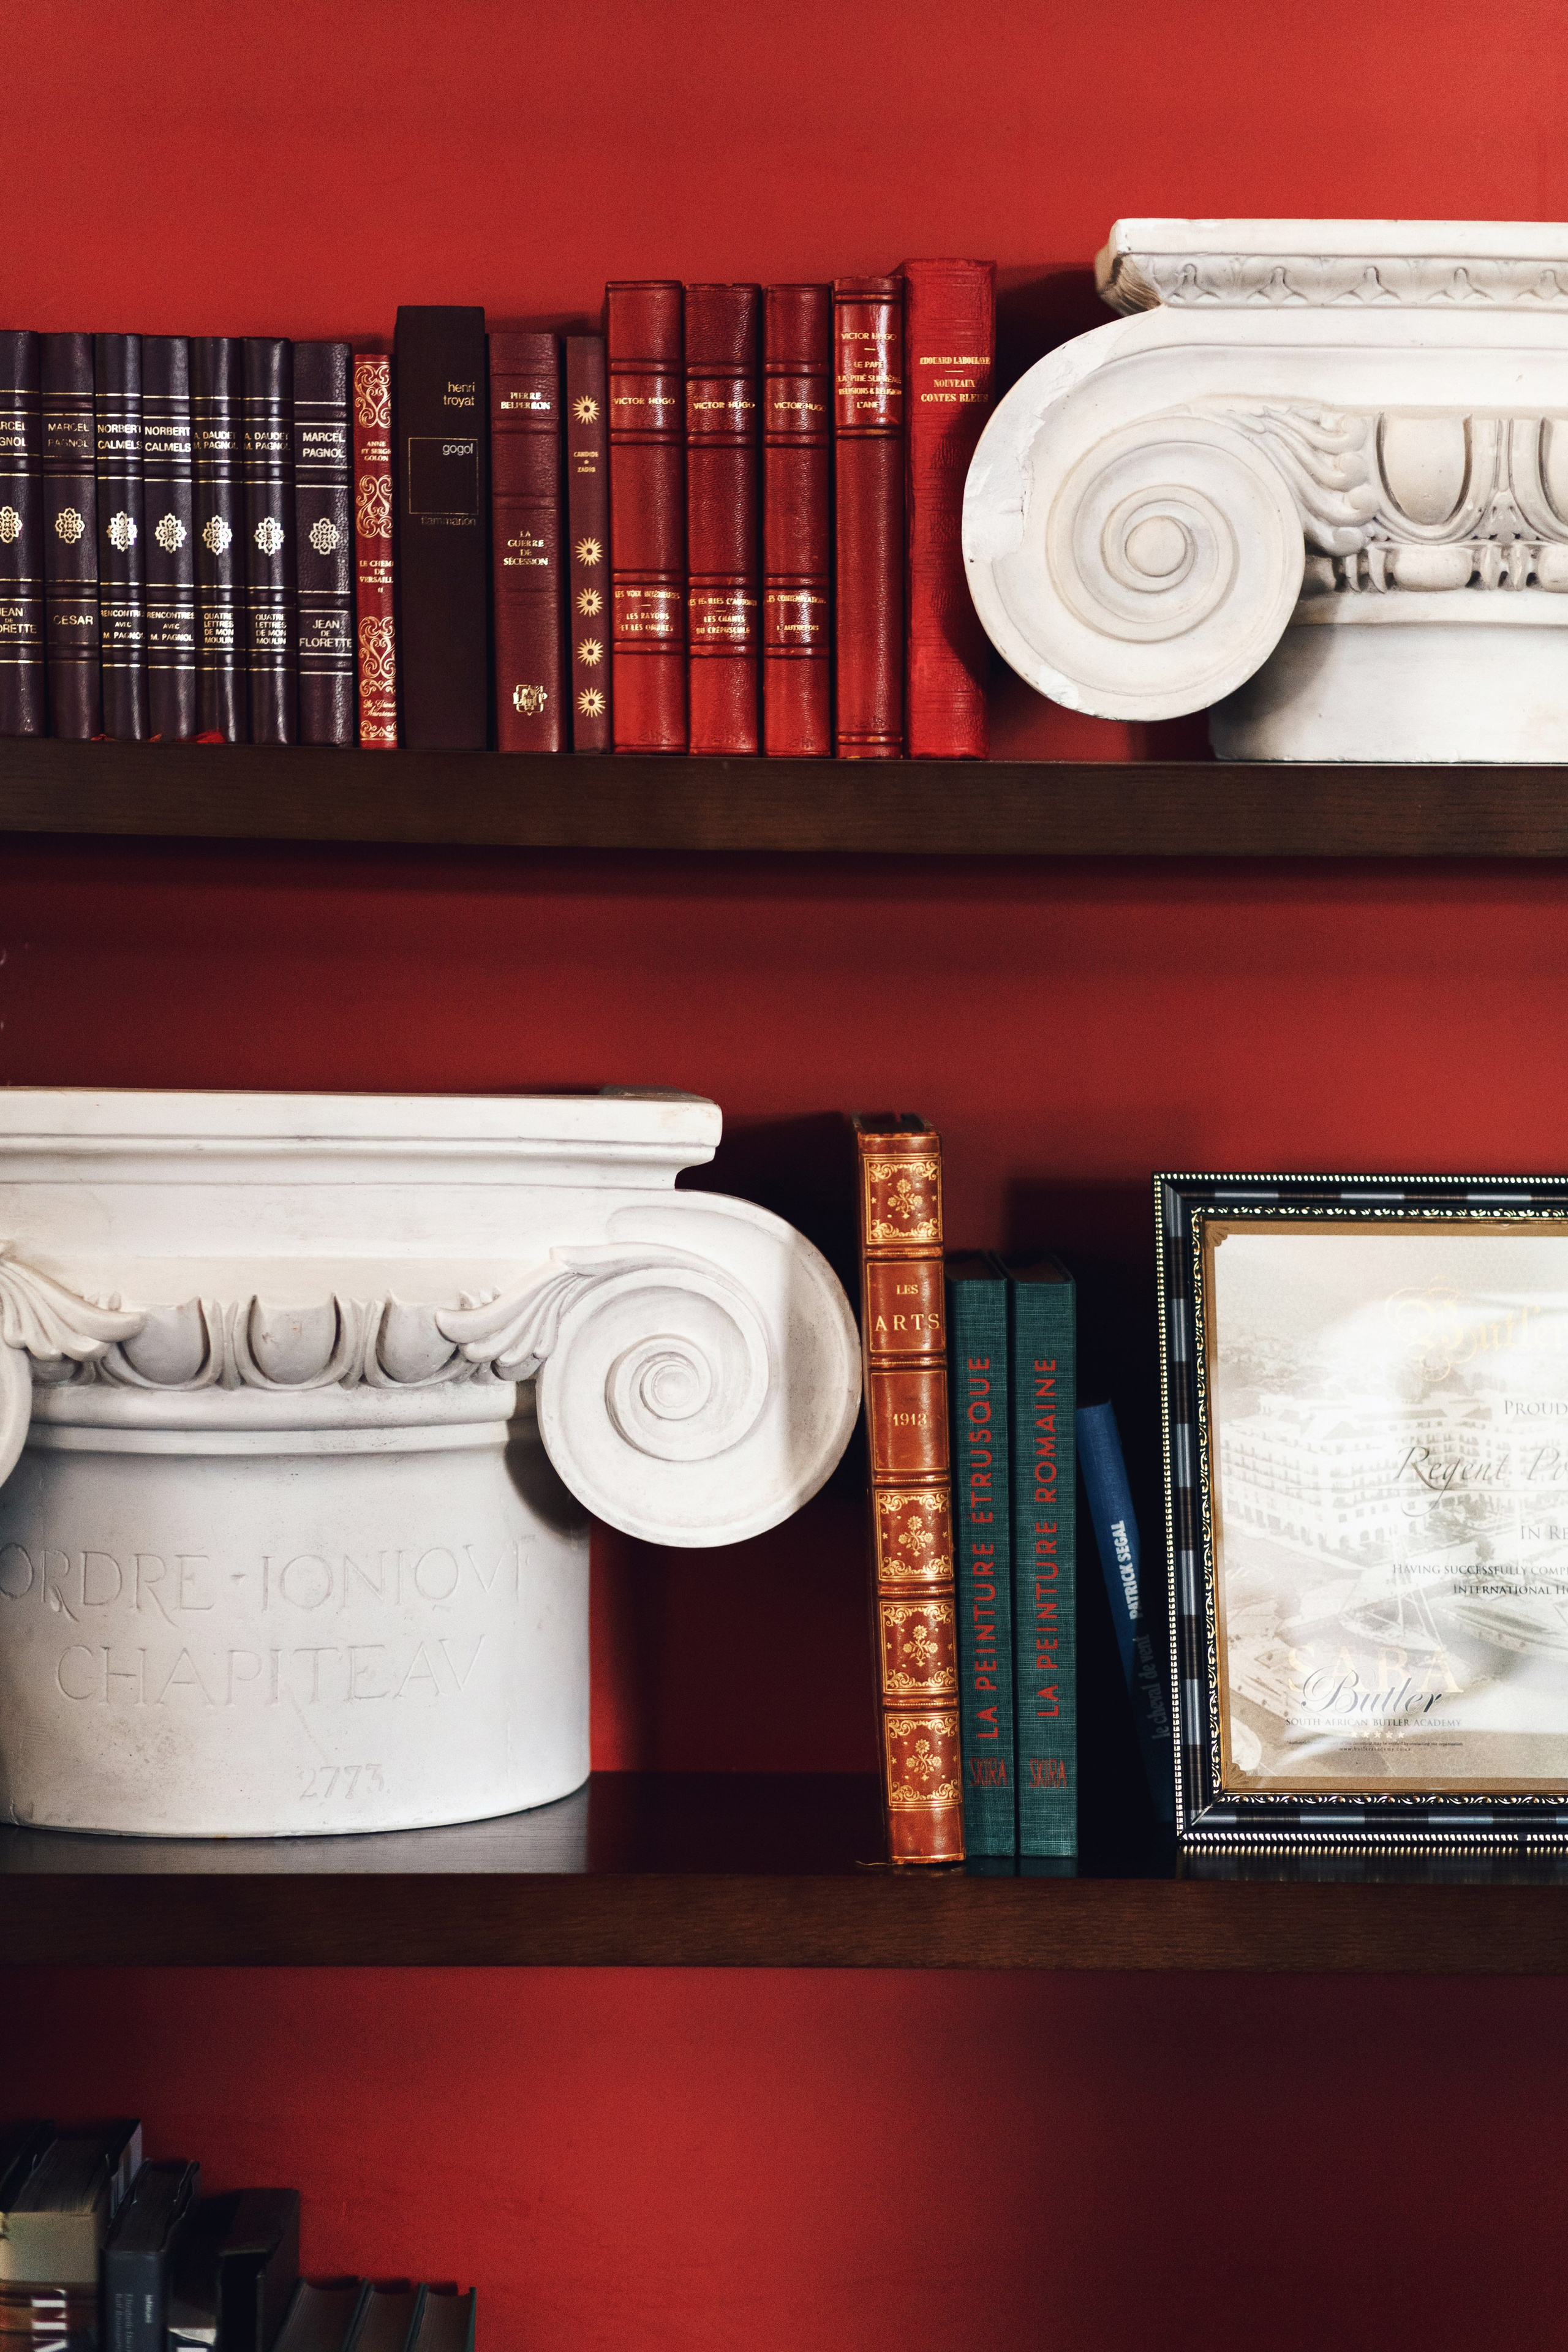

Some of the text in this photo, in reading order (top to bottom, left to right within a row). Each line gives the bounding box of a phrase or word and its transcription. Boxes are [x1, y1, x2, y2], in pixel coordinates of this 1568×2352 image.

[872, 332, 897, 341] HUGO
[448, 382, 475, 392] henri
[933, 379, 976, 388] NOUVEAUX
[443, 395, 475, 408] troyat
[921, 393, 989, 402] CONTES BLEUS
[500, 401, 551, 410] BELPERRON
[805, 403, 826, 412] HUGO
[0, 421, 28, 431] RCEL
[48, 423, 90, 432] MARCEL
[97, 424, 141, 434] NORBERT
[145, 426, 190, 436] NORBERT
[203, 431, 236, 440] DAUDET
[254, 432, 289, 440] DAUDET
[303, 432, 346, 442] MARCEL
[48, 439, 89, 447] PAGNOL
[97, 440, 143, 450] CALMELS
[145, 442, 192, 452] CALMELS
[203, 441, 238, 450] PAGNOL
[255, 442, 291, 450] PAGNOL
[303, 448, 346, 458] PAGNOL
[442, 443, 473, 456] gogol
[503, 556, 549, 565] SÉCESSION
[53, 615, 93, 625] CESAR
[147, 611, 195, 620] RENCONTRES
[312, 619, 339, 629] JEAN
[299, 638, 352, 647] FLORETTE
[897, 1284, 919, 1295] LES
[875, 1313, 940, 1332] ARTS
[892, 1412, 927, 1427] 1913
[1394, 1446, 1509, 1517] Regent
[1521, 1525, 1540, 1539] IN
[1035, 1359, 1060, 1717] LA PEINTURE ROMAINE
[968, 1358, 999, 1739] LA PEINTURE ÉTRUSQUE
[1111, 1520, 1144, 1620] PATRICK SEGAL
[1393, 1564, 1440, 1575] HAVING
[1531, 1566, 1568, 1575] COMP
[0, 1543, 214, 1627] ORDRE
[1453, 1584, 1551, 1595] INTERNATIONAL
[1133, 1634, 1153, 1660] vent
[56, 1634, 486, 1709] CHAPITEAV
[1138, 1662, 1158, 1680] de
[1301, 1665, 1444, 1714] Butler
[1142, 1683, 1167, 1725] cheval
[1286, 1717, 1462, 1727] SOUTH AFRICAN BUTLER ACADEMY
[970, 1757, 1008, 1787] SKIRA
[1030, 1758, 1067, 1788] SKIRA
